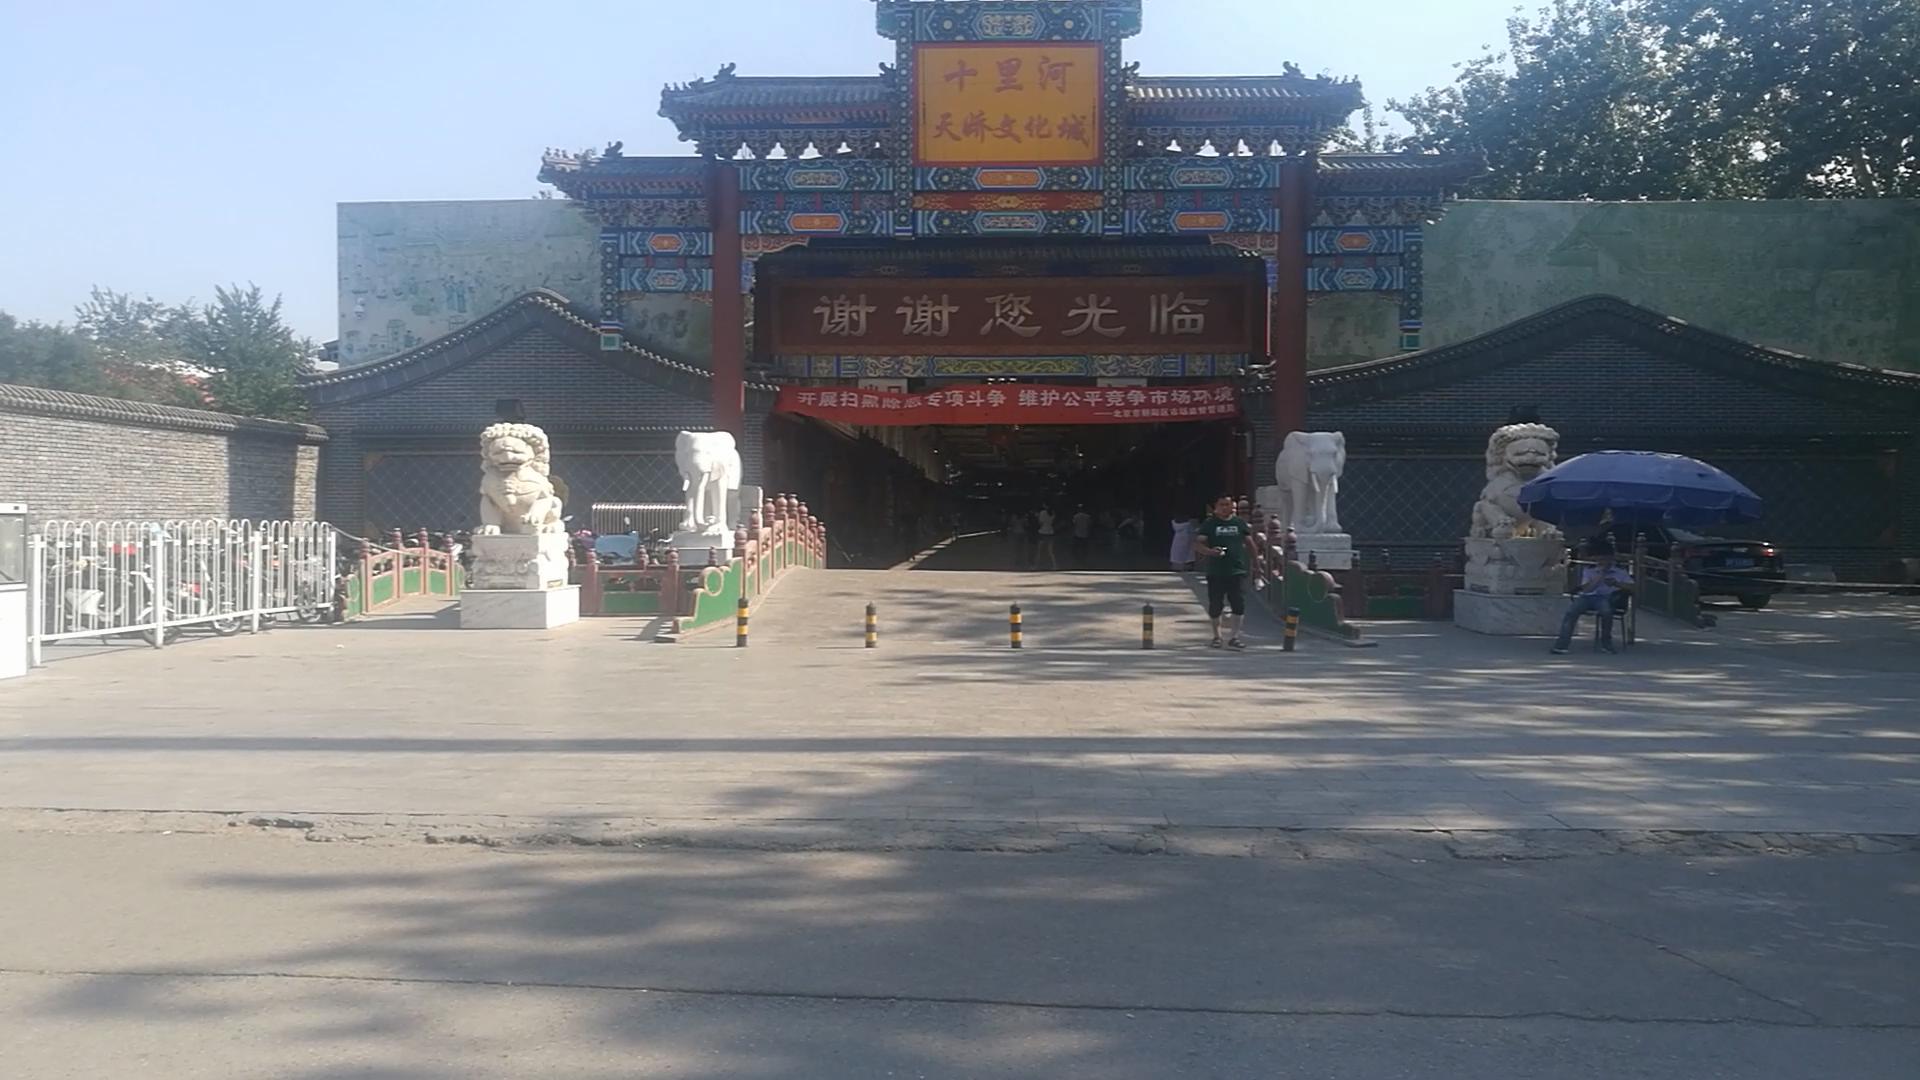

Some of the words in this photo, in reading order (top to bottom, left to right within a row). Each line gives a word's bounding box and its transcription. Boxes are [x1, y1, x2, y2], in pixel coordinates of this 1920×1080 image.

[944, 55, 1075, 94] 十里河
[812, 292, 1209, 338] 谢谢您光临
[796, 389, 1007, 410] 开展扫黑除恶专项斗争
[1018, 386, 1235, 408] 维护公平竞争市场环境
